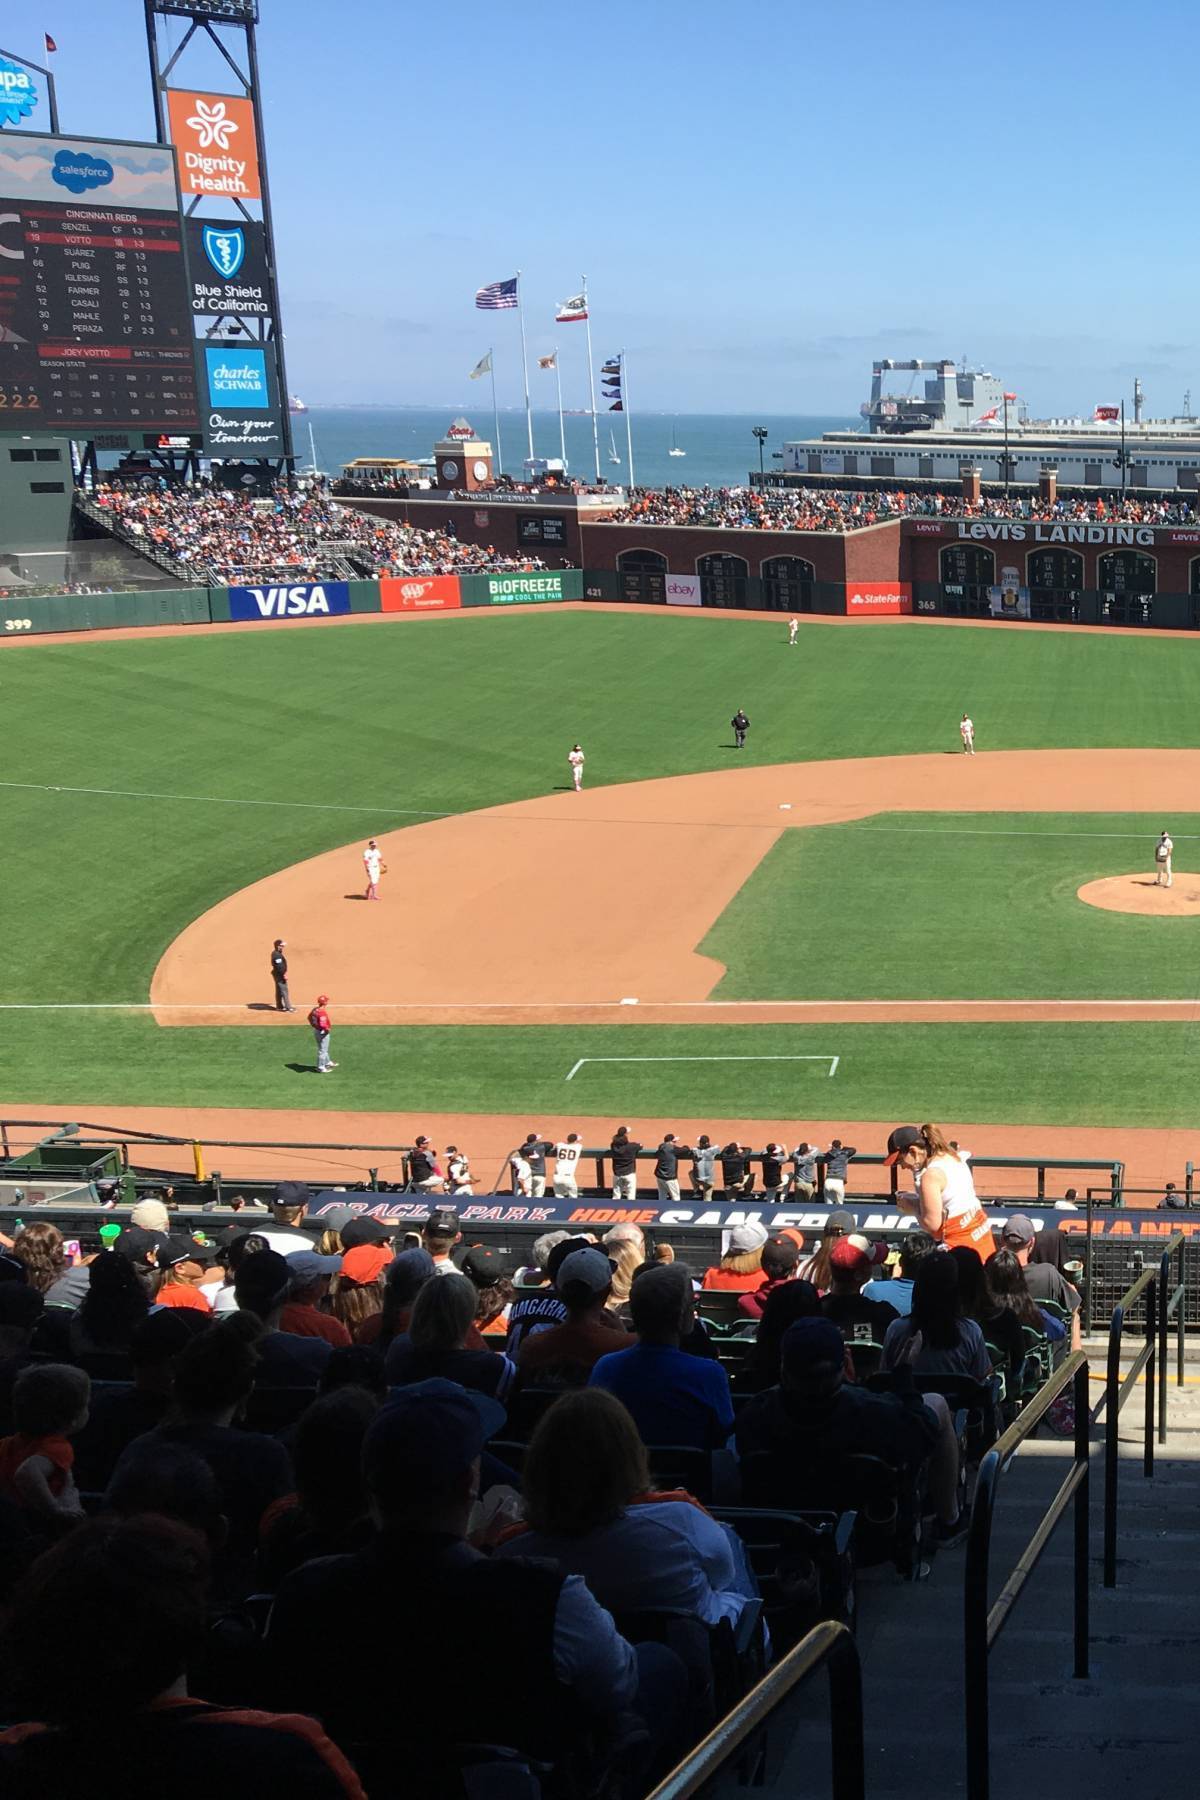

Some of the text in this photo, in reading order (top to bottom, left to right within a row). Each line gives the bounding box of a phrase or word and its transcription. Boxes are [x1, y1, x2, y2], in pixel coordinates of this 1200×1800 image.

[0, 71, 29, 91] pa
[185, 152, 246, 176] Dignity
[60, 165, 109, 178] salesforce
[66, 210, 138, 223] CINCINNATI REDS
[61, 222, 92, 232] SENZEL
[64, 236, 92, 245] VOTTO
[71, 261, 91, 270] PUIG
[64, 274, 100, 283] IGLESIAS
[68, 286, 100, 295] FARMER
[195, 283, 262, 299] Blue Shield
[71, 299, 99, 308] CASALI
[192, 298, 268, 313] of California
[73, 312, 100, 321] MAHLE
[72, 324, 103, 334] PERAZA
[61, 348, 111, 358] JOEY VOTTO
[213, 364, 260, 380] charles
[214, 380, 262, 391] SCHWAB
[209, 414, 275, 434] Own your
[209, 430, 279, 443] tomorrow
[447, 425, 475, 437] Coors
[1035, 525, 1155, 545] LANDING
[547, 592, 562, 600] PAIN
[587, 587, 602, 597] 421
[667, 583, 695, 597] ebay
[246, 586, 330, 616] VISA
[918, 601, 935, 610] 365
[5, 618, 31, 631] 399
[559, 1149, 576, 1161] 60
[459, 1205, 556, 1220] PARK
[568, 1208, 660, 1223] HOME
[659, 1210, 763, 1225] SAN
